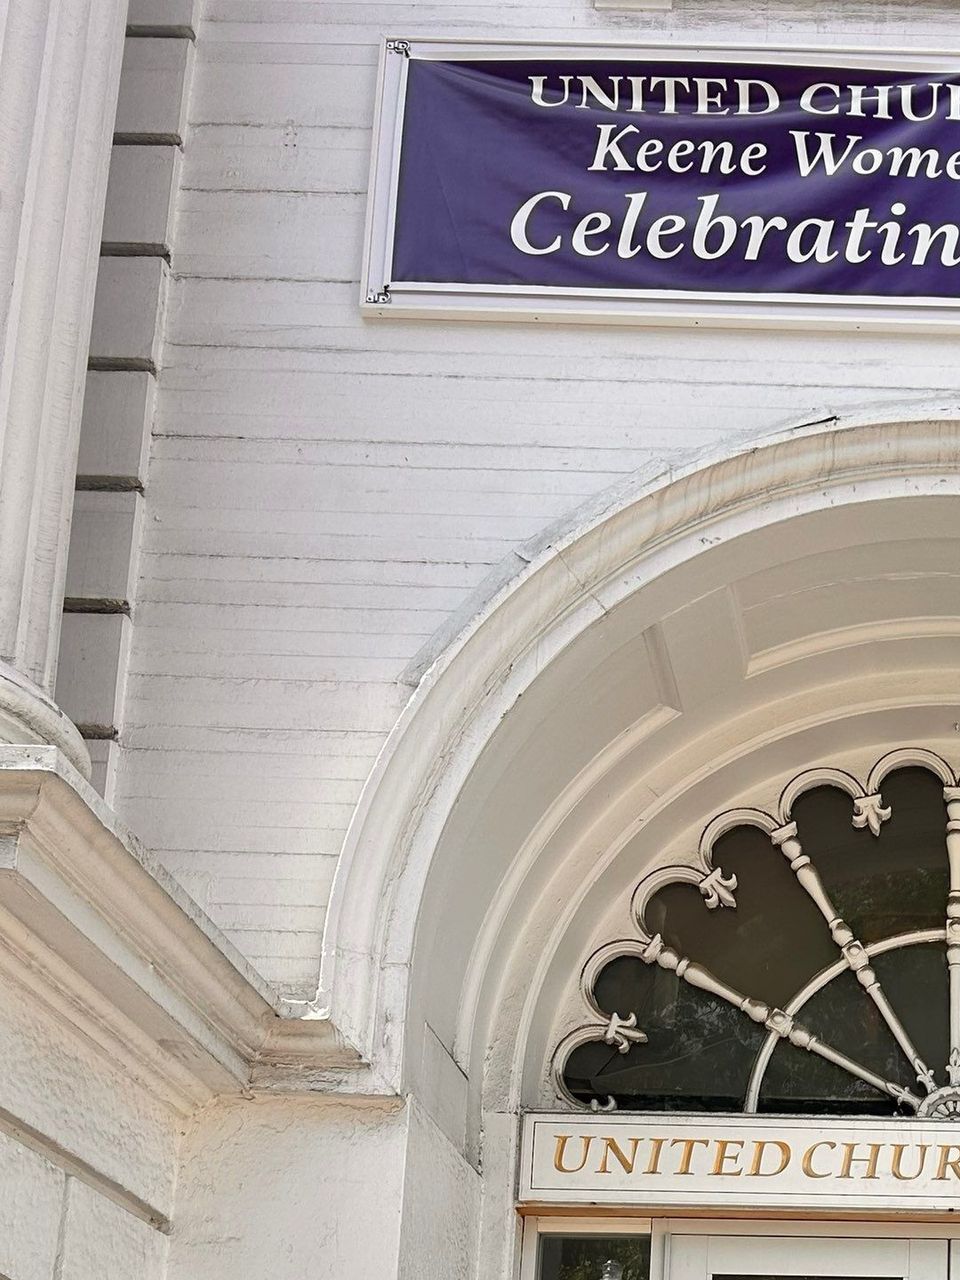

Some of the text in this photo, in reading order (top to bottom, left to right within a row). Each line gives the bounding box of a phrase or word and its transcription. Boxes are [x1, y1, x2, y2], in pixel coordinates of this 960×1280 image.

[527, 75, 780, 116] UNITED
[587, 124, 768, 176] Keene
[553, 1134, 791, 1177] UNITED
